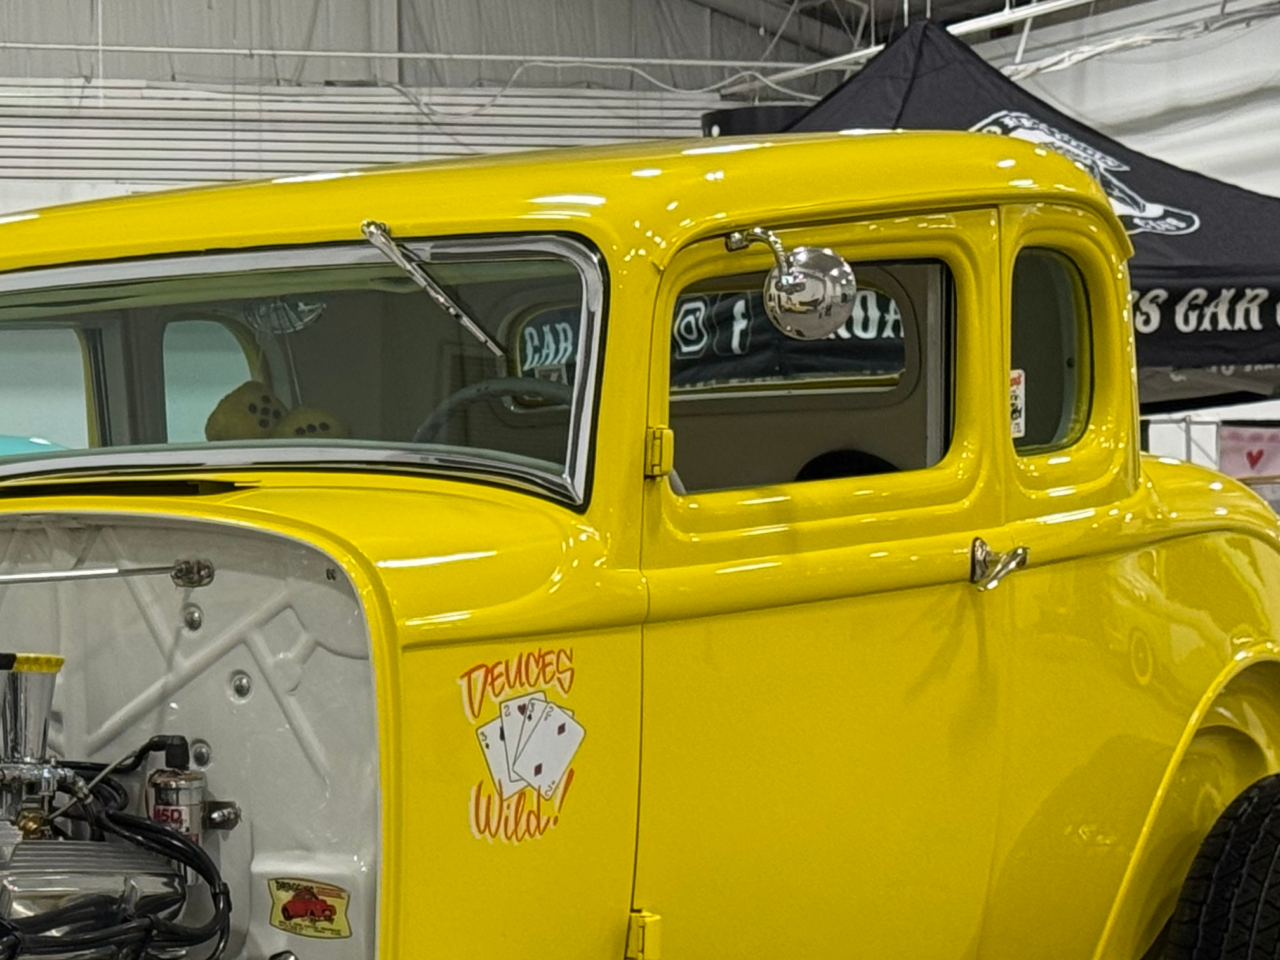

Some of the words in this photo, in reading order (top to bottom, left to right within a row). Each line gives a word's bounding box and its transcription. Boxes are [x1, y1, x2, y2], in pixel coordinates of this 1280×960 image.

[828, 290, 904, 339] OA
[1131, 288, 1169, 334] S
[1175, 287, 1269, 333] CAR
[522, 322, 573, 371] CAR
[458, 648, 574, 722] DEUCES
[470, 768, 575, 843] Wild!
